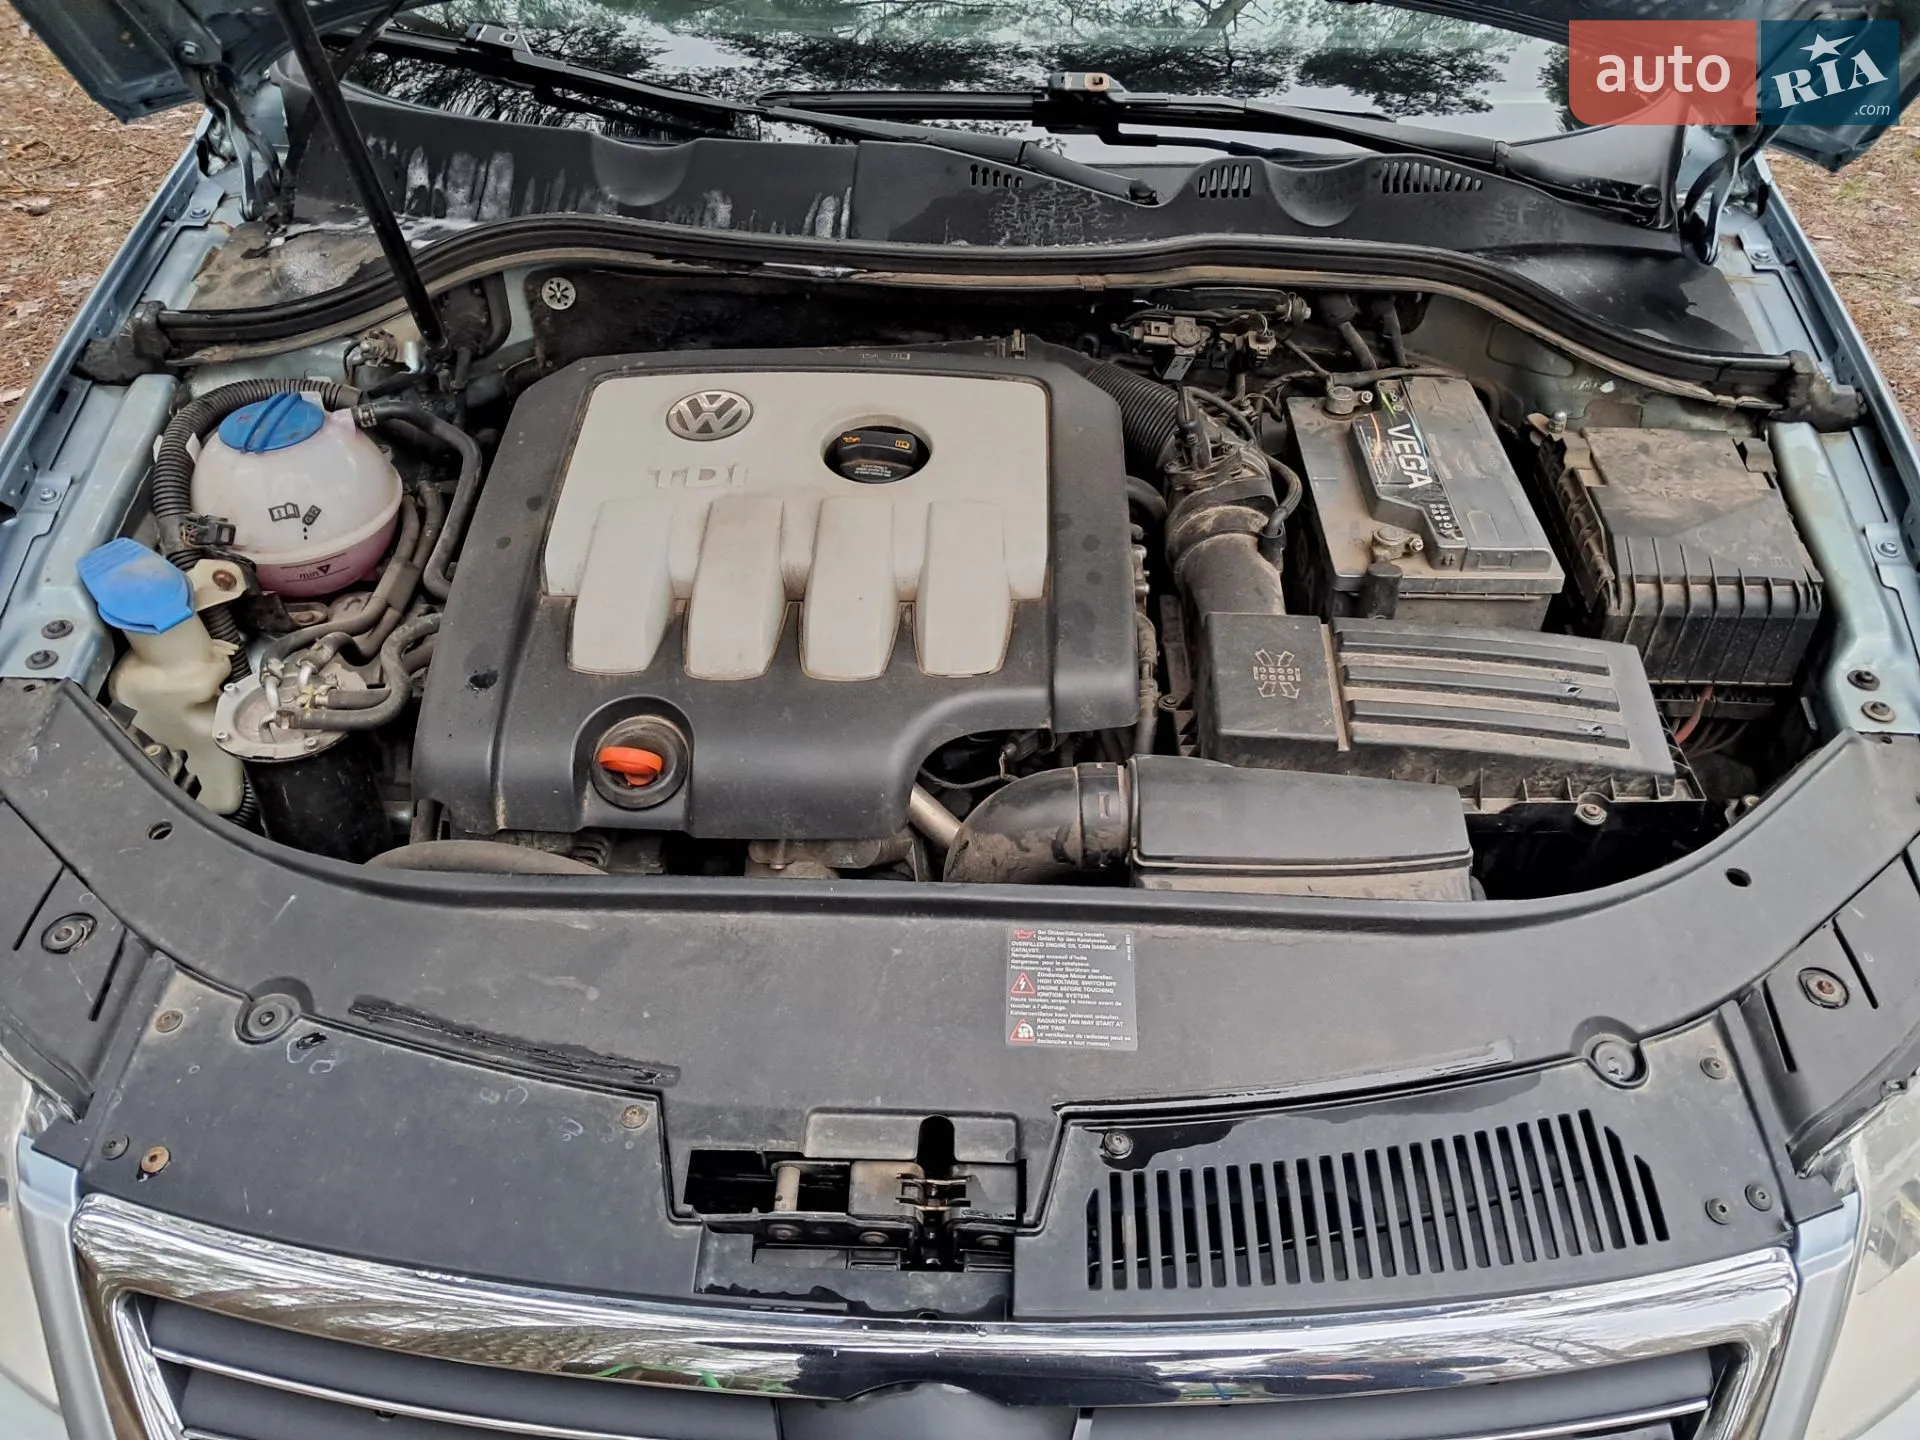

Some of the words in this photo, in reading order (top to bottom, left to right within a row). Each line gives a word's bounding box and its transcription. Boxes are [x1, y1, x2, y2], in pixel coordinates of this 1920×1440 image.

[1387, 423, 1432, 489] VEGA
[648, 463, 749, 489] TDI
[299, 571, 319, 580] min
